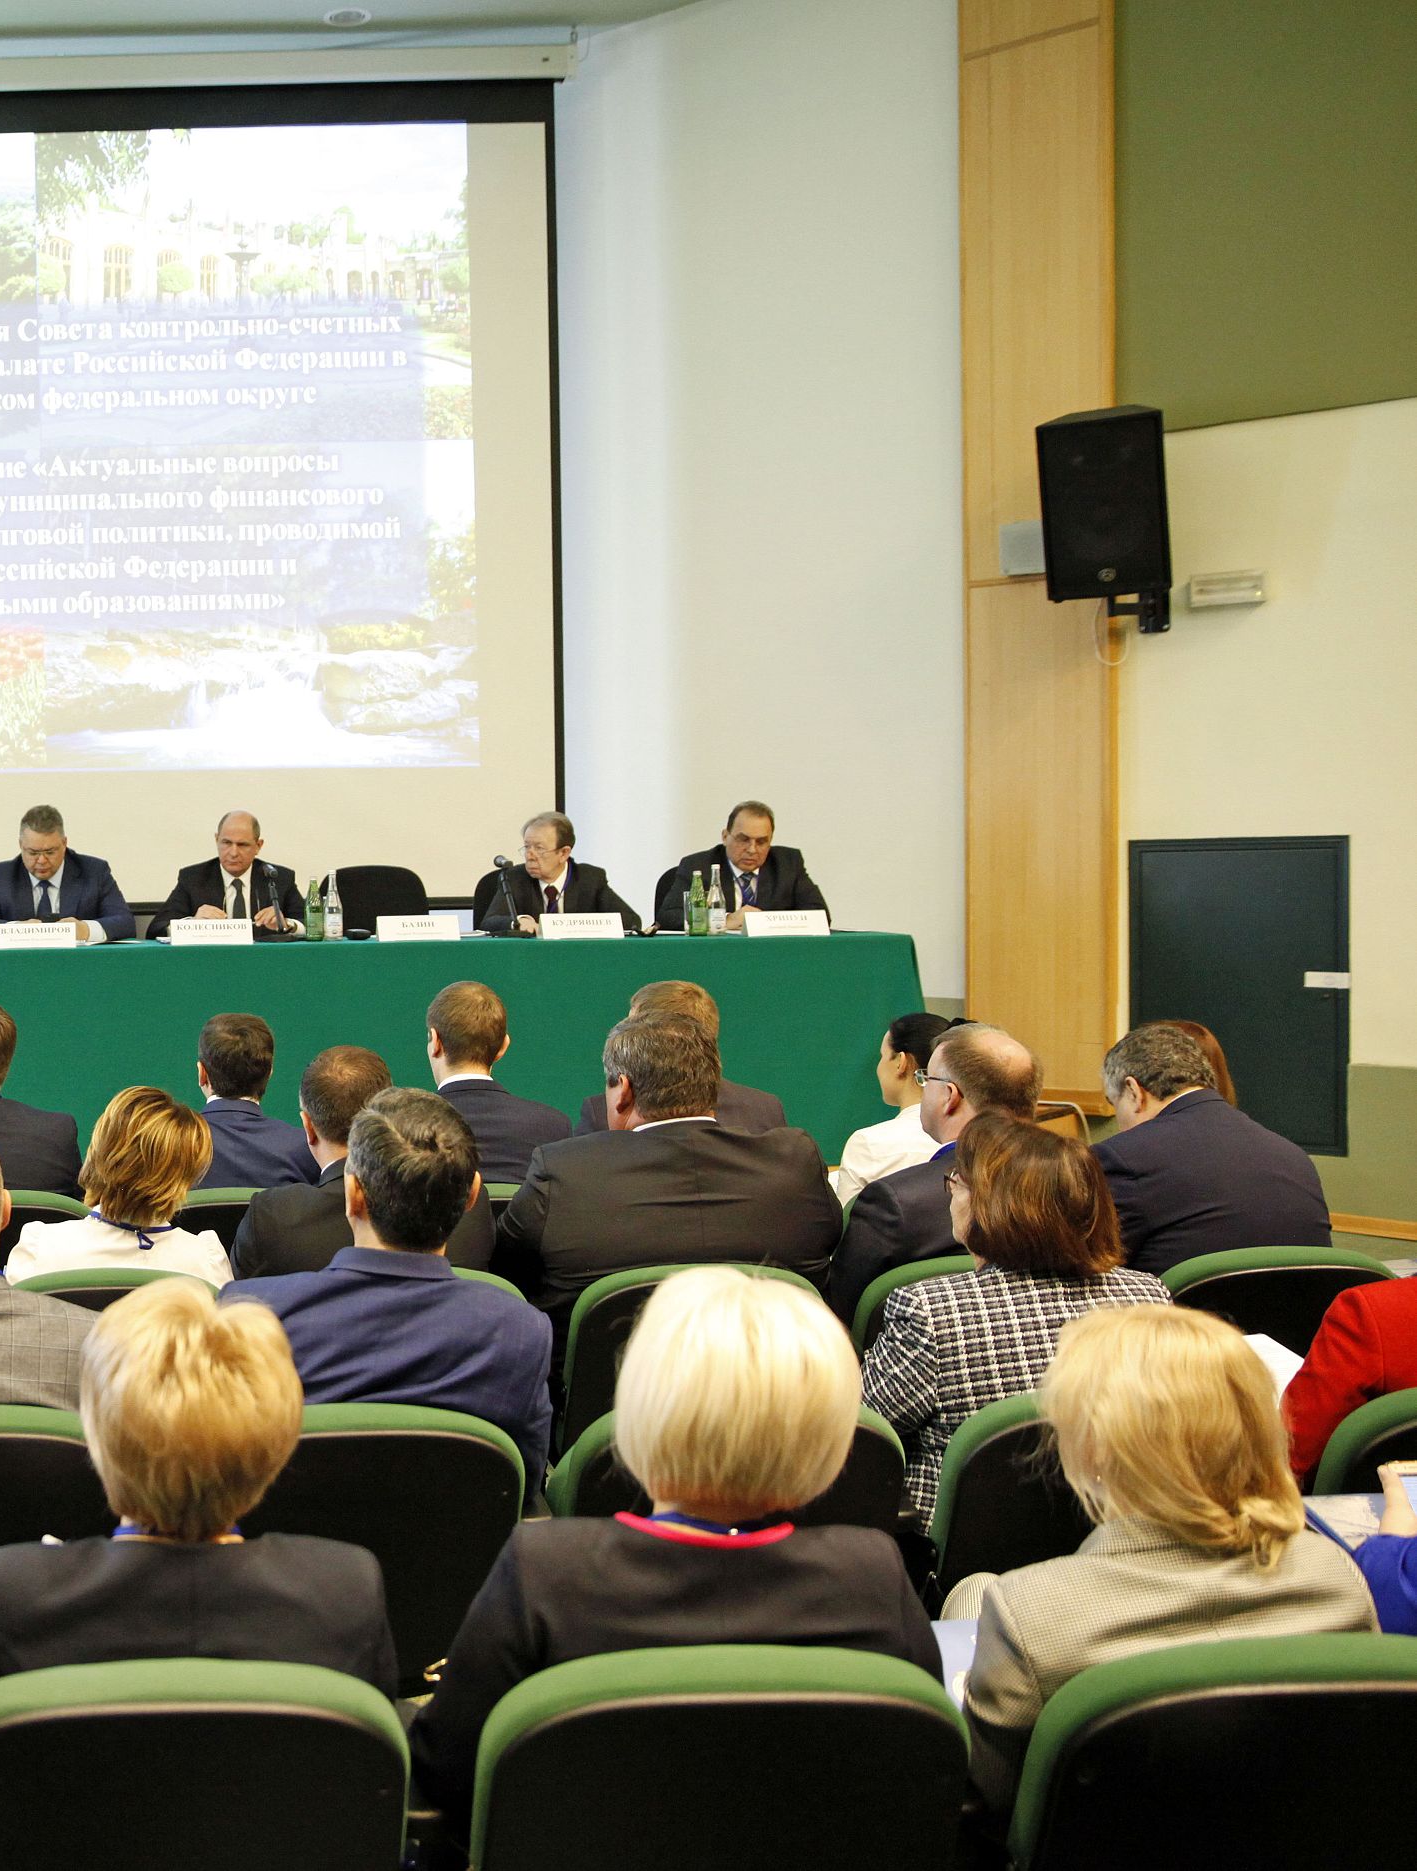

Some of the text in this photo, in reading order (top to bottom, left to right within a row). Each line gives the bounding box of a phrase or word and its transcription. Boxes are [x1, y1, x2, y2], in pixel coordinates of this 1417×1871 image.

[17, 319, 113, 344] Совета
[120, 316, 402, 343] контрольно-счетных
[73, 348, 227, 376] Российской
[234, 347, 386, 374] Федерации
[392, 350, 408, 367] в
[42, 384, 220, 414] федеральном
[225, 384, 318, 410] округе
[33, 454, 216, 482] «Актуальные
[223, 452, 340, 478] вопросы
[209, 485, 384, 513] финансового
[92, 521, 233, 545] политики,
[239, 517, 401, 546] проводимой
[123, 554, 275, 582] Федерации
[281, 557, 297, 575] и
[63, 591, 286, 618] образованиями»
[0, 926, 71, 935] ВЛАДИМИРОВ
[176, 923, 247, 931] КОЛЕСНИКОВ
[401, 920, 435, 928] БАЗИН
